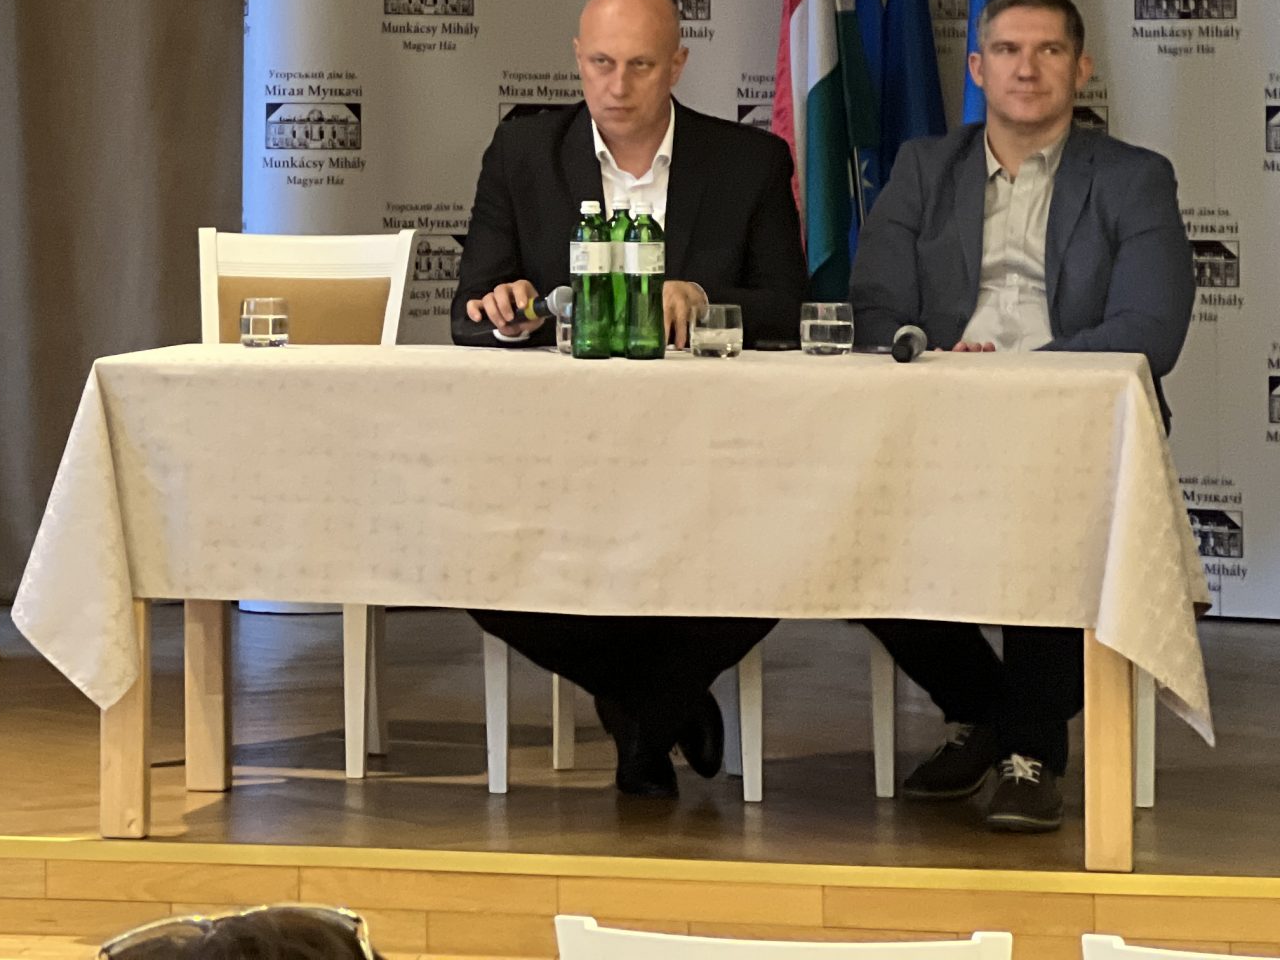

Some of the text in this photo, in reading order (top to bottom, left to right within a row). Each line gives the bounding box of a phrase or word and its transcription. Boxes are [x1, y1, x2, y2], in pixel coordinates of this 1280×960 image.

[382, 22, 479, 38] Munkácsy Mihály
[1132, 26, 1242, 40] Munkácsy Mihály
[265, 84, 362, 100] Мігая Мункачі
[499, 85, 584, 100] Мігая Мункач
[263, 156, 366, 172] Munkácsy Mihály
[383, 216, 415, 228] Мігая
[1200, 294, 1245, 309] Mihály
[408, 306, 431, 317] agyar
[1182, 490, 1242, 505] Мункачі
[1204, 564, 1248, 580] Mihály
